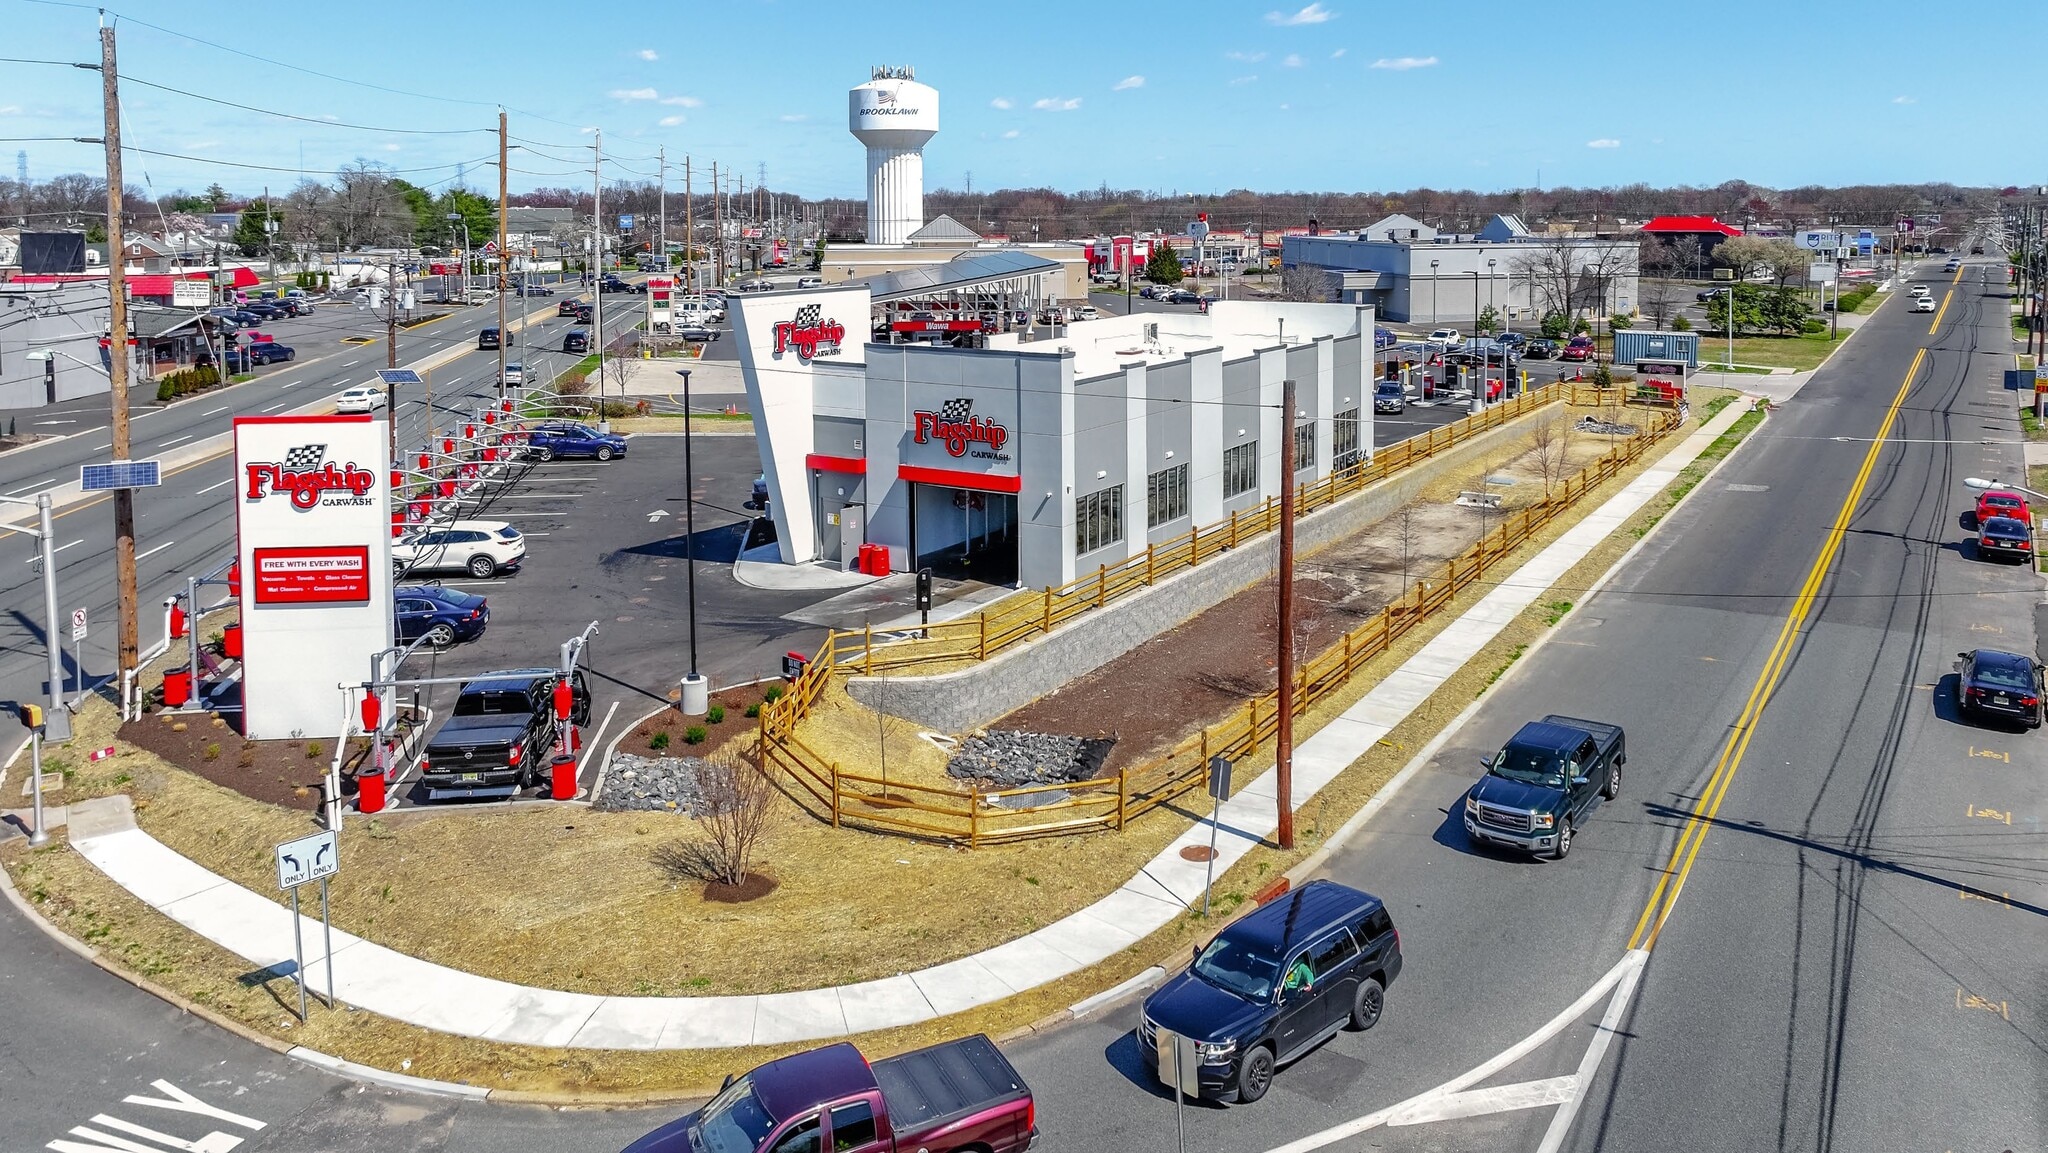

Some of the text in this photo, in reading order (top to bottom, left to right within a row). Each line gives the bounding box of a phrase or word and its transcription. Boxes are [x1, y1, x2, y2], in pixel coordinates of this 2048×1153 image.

[859, 108, 919, 116] BROOKLAWN
[925, 322, 949, 330] Wawa
[774, 317, 845, 359] Flagship
[813, 349, 841, 358] CARWASH
[914, 410, 1009, 457] Flagship
[971, 450, 1009, 461] CARWASH
[245, 461, 376, 509] Flagship
[322, 498, 373, 507] CARWASH
[313, 863, 333, 876] ONLY
[285, 872, 305, 885] ONLY
